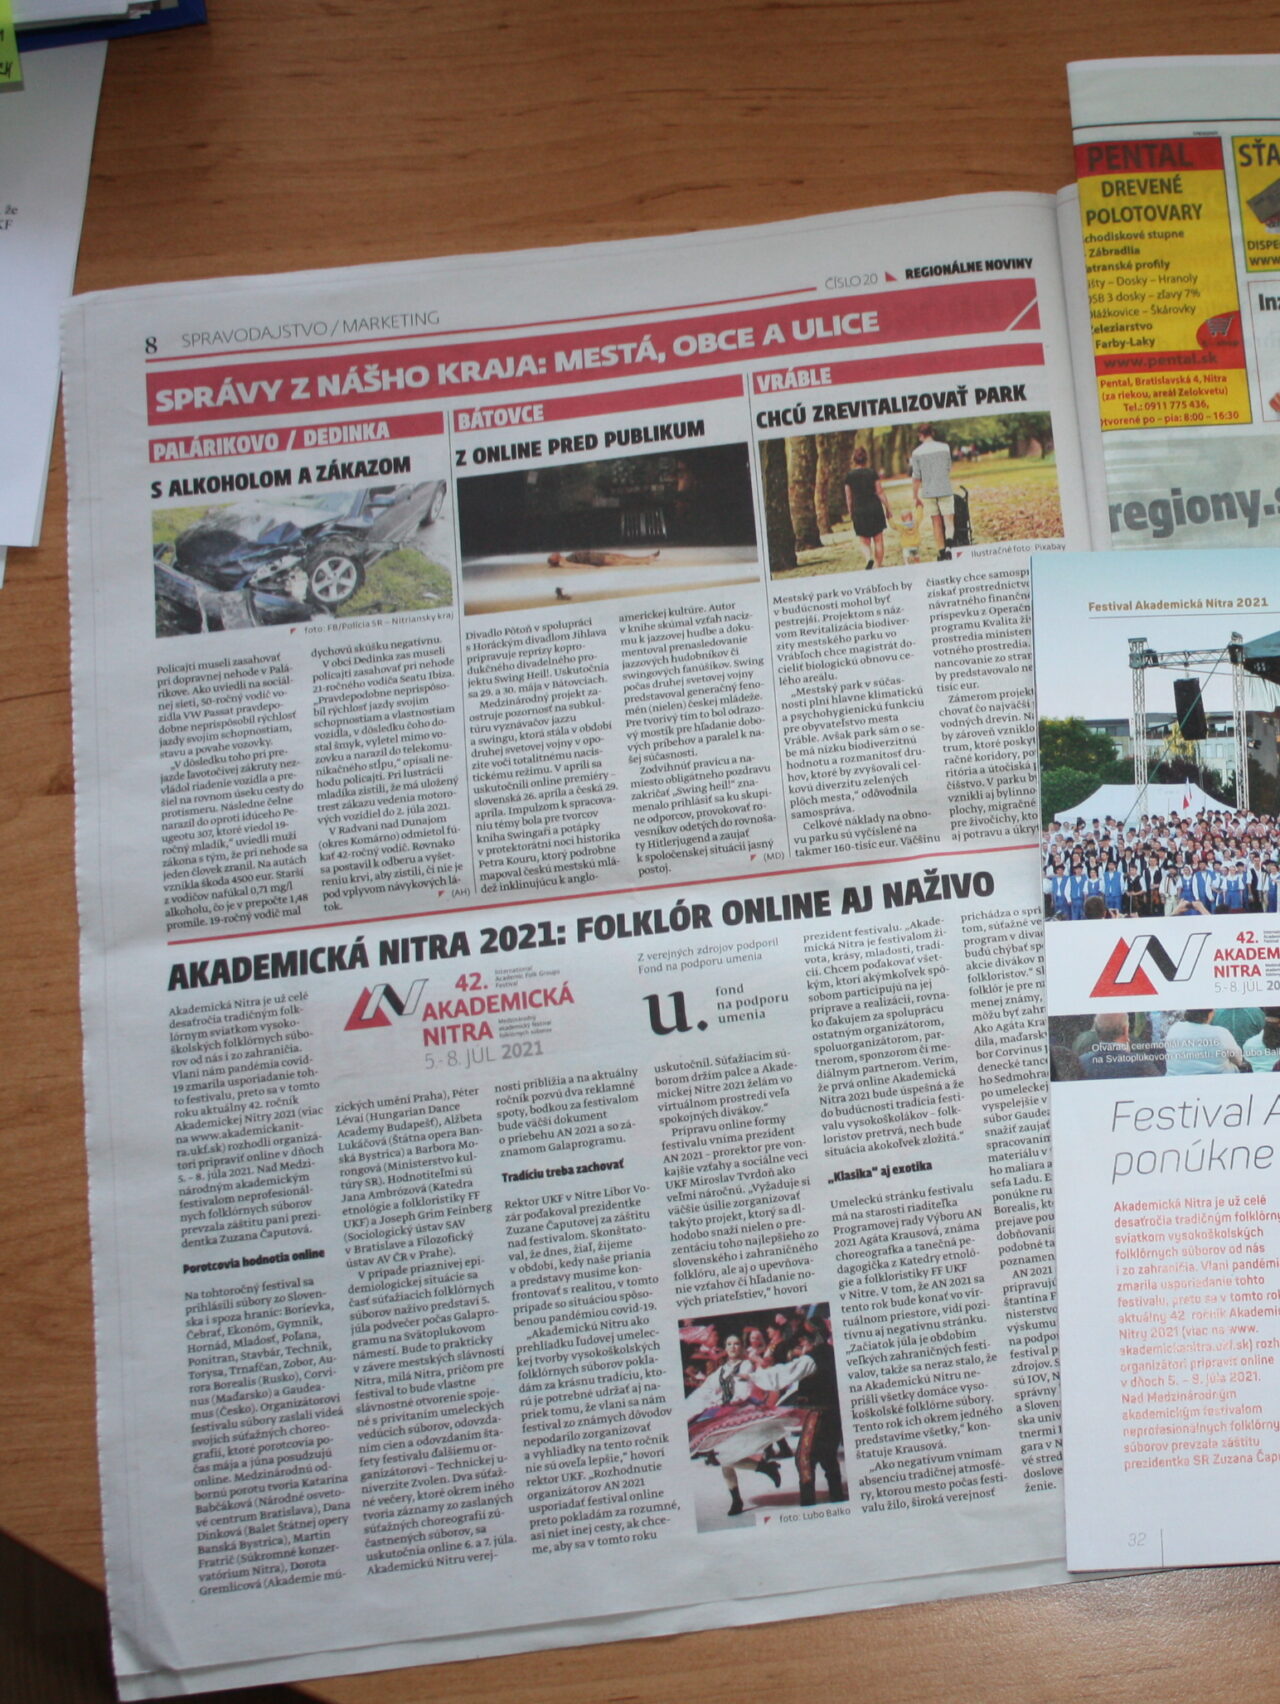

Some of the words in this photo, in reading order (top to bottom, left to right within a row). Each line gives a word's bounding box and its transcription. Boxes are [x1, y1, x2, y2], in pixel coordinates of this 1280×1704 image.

[1087, 143, 1194, 171] PENTAL
[1101, 174, 1182, 197] DREVENÉ
[1086, 204, 1203, 225] POLOTOVARY
[1148, 228, 1184, 242] stupne
[905, 259, 983, 280] REGIONÁLNE
[984, 257, 1033, 271] NOVINY
[1136, 259, 1170, 273] profily
[825, 273, 861, 291] ČÍSLO
[863, 271, 879, 287] 20
[1116, 276, 1149, 288] Dosky
[1158, 272, 1198, 287] Hranoly
[1115, 291, 1147, 304] dosky
[1151, 302, 1196, 317] Škárovky
[145, 336, 158, 354] 8
[181, 320, 328, 348] SPRAVODAJSTVO
[342, 310, 441, 334] MARKETING
[1095, 336, 1155, 349] Farby-Laky
[155, 376, 283, 413] SPRÁVY
[290, 376, 310, 400] Z
[317, 363, 430, 397] NÁŠHO
[438, 355, 547, 385] KRAJA:
[553, 333, 667, 375] MESTÁ,
[672, 328, 755, 358] OBCE
[762, 323, 785, 344] A
[792, 311, 880, 339] ULICE
[1103, 351, 1217, 369] www.pental.sk
[757, 366, 832, 391] VRÁBLE
[1135, 373, 1191, 387] Bratislavská
[1204, 373, 1227, 383] Nitra
[756, 403, 807, 429] CHCÚ
[812, 384, 969, 423] ZREVITALIZOVAŤ
[975, 384, 1027, 405] PARK
[1144, 401, 1165, 410] 0911
[1168, 400, 1186, 409] 775
[457, 403, 544, 430] BÁTOVCE
[153, 431, 280, 461] PALÁRIKOVO
[303, 421, 390, 448] DEDINKA
[455, 449, 467, 466] Z
[472, 440, 543, 465] ONLINE
[548, 432, 598, 456] PRED
[604, 419, 705, 449] PUBLIKUM
[150, 481, 163, 499] S
[168, 469, 292, 498] ALKOHOLOM
[298, 466, 312, 484] A
[316, 455, 412, 481] ZÁKAZOM
[773, 591, 814, 606] Mestský
[1088, 600, 1133, 612] Festival
[1134, 598, 1203, 611] Akademická
[1205, 598, 1233, 609] Nitra
[1236, 597, 1269, 608] 2021
[619, 609, 667, 624] americkej
[465, 627, 503, 641] Divadlo
[157, 662, 196, 675] Policajti
[166, 936, 370, 992] AKADEMICKÁ
[378, 931, 471, 966] NITRA
[480, 921, 567, 954] 2021:
[576, 899, 711, 945] FOLKLÓR
[722, 890, 832, 928] ONLINE
[841, 885, 875, 914] AJ
[882, 868, 996, 909] NAŽIVO
[1236, 931, 1259, 944] 42.
[647, 947, 695, 964] verejných
[697, 943, 732, 959] zdrojov
[734, 937, 779, 956] podporil
[638, 963, 661, 976] Fond
[664, 962, 677, 973] na
[679, 958, 718, 974] podporu
[720, 952, 763, 966] umenia
[1214, 964, 1262, 978] NITRA
[454, 972, 489, 993] 42.
[715, 982, 744, 997] fond
[1242, 979, 1262, 994] JÚL
[168, 1001, 233, 1017] Akademická
[234, 998, 261, 1010] Nitra
[421, 984, 576, 1022] AKADEMICKÁ
[717, 998, 733, 1010] na
[736, 992, 789, 1010] podporu
[718, 1008, 766, 1025] umenia
[422, 1020, 494, 1047] NITRA
[464, 1045, 496, 1071] JÚL
[501, 1040, 544, 1060] 2021
[1110, 1094, 1253, 1133] Festival
[502, 1168, 544, 1183] Tradíciu
[546, 1165, 575, 1178] treba
[577, 1158, 624, 1175] zachovať
[880, 1165, 890, 1178] aj
[892, 1161, 933, 1174] exotika
[1110, 1138, 1275, 1185] ponúkne
[1114, 1200, 1181, 1212] Akademická
[183, 1258, 240, 1274] Porotcovia
[242, 1252, 290, 1267] hodnotia
[292, 1248, 325, 1260] online
